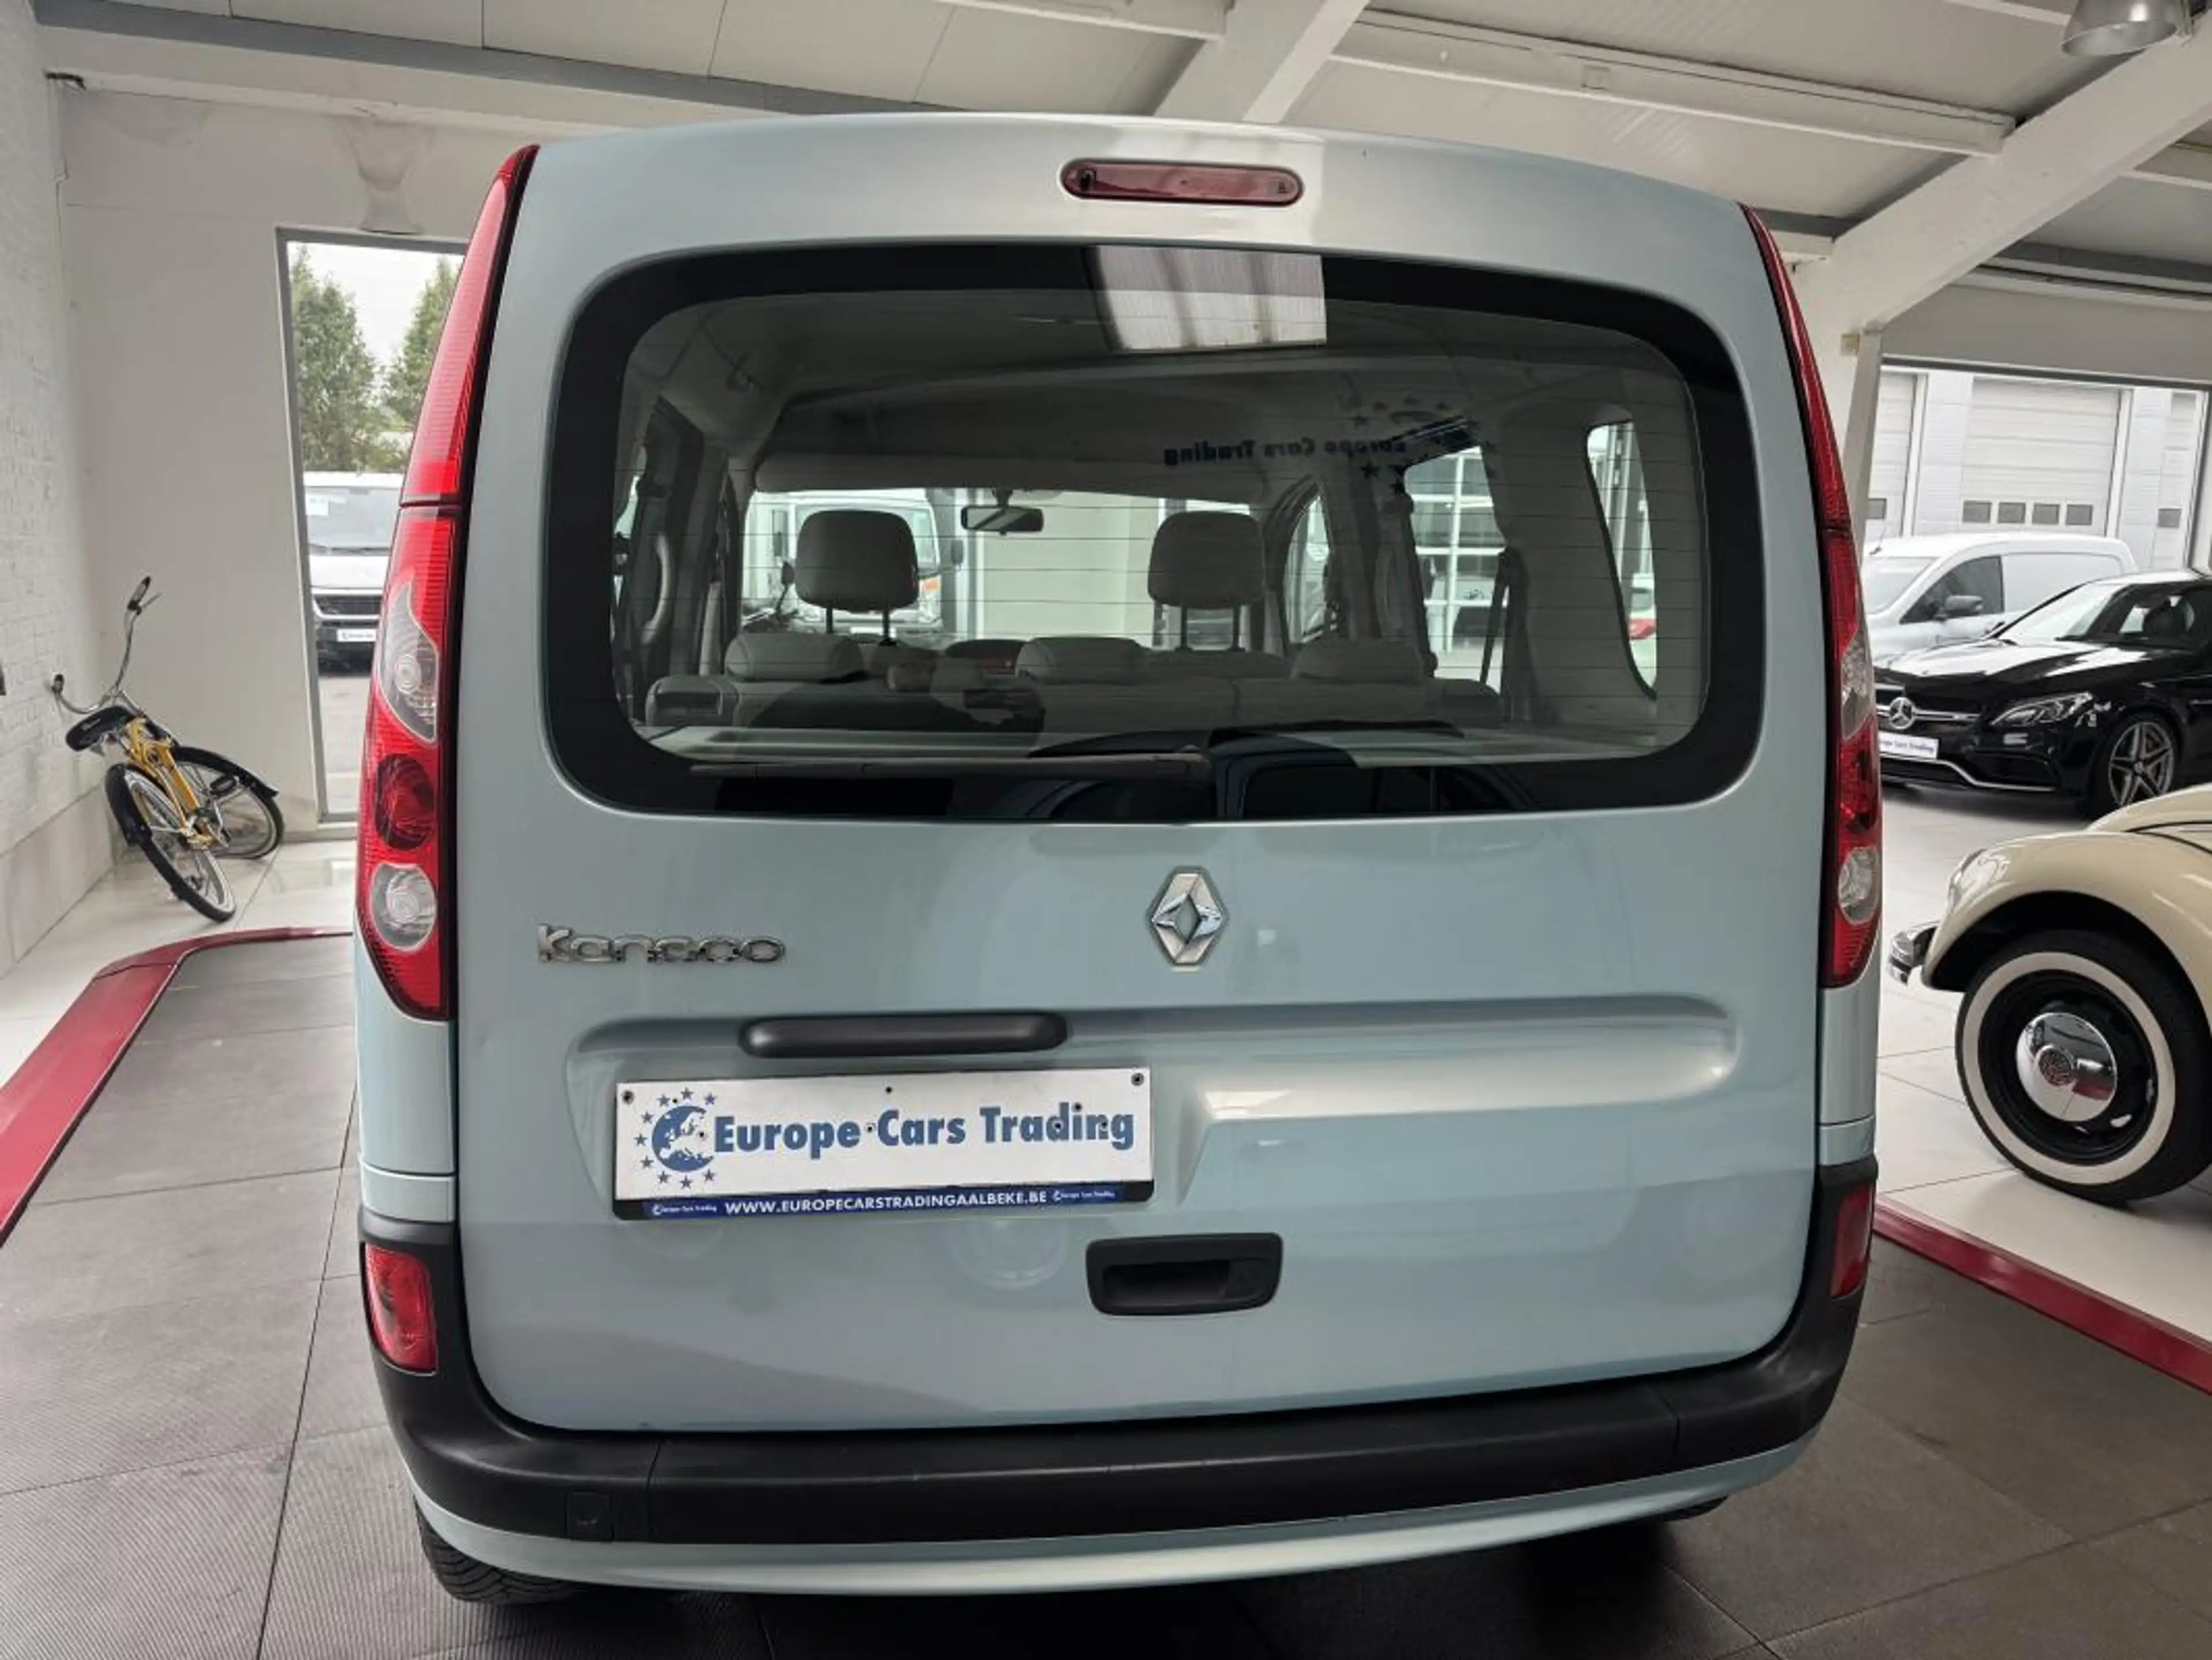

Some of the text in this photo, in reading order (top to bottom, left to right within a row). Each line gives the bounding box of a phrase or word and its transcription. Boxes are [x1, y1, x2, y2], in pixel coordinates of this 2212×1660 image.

[714, 1101, 1134, 1160] Europe Cars Trading
[725, 1190, 1047, 1215] WWW.EUROPECARSTRADINGAALBEKE.BE
